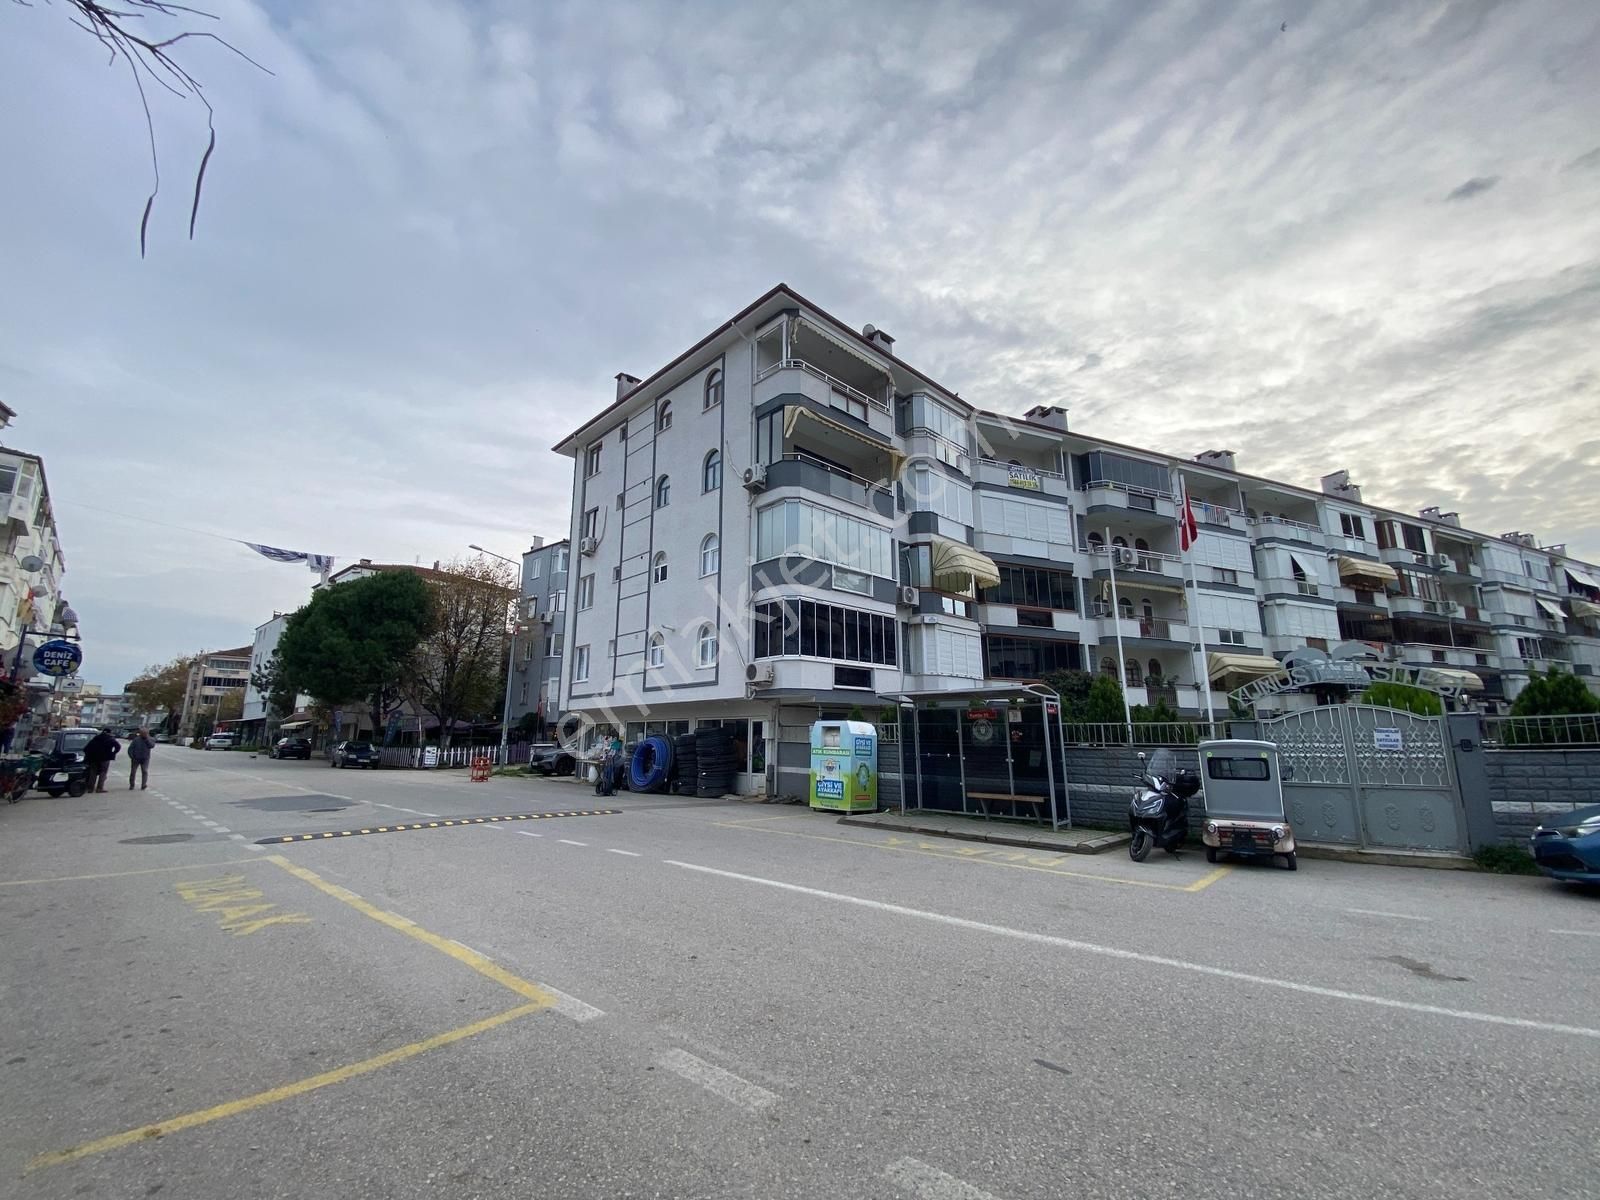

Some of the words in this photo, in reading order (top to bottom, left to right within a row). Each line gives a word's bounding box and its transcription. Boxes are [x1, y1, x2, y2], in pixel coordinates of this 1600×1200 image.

[1009, 471, 1037, 481] SATILIK
[44, 651, 73, 660] DENİZ
[44, 659, 69, 667] CAFE
